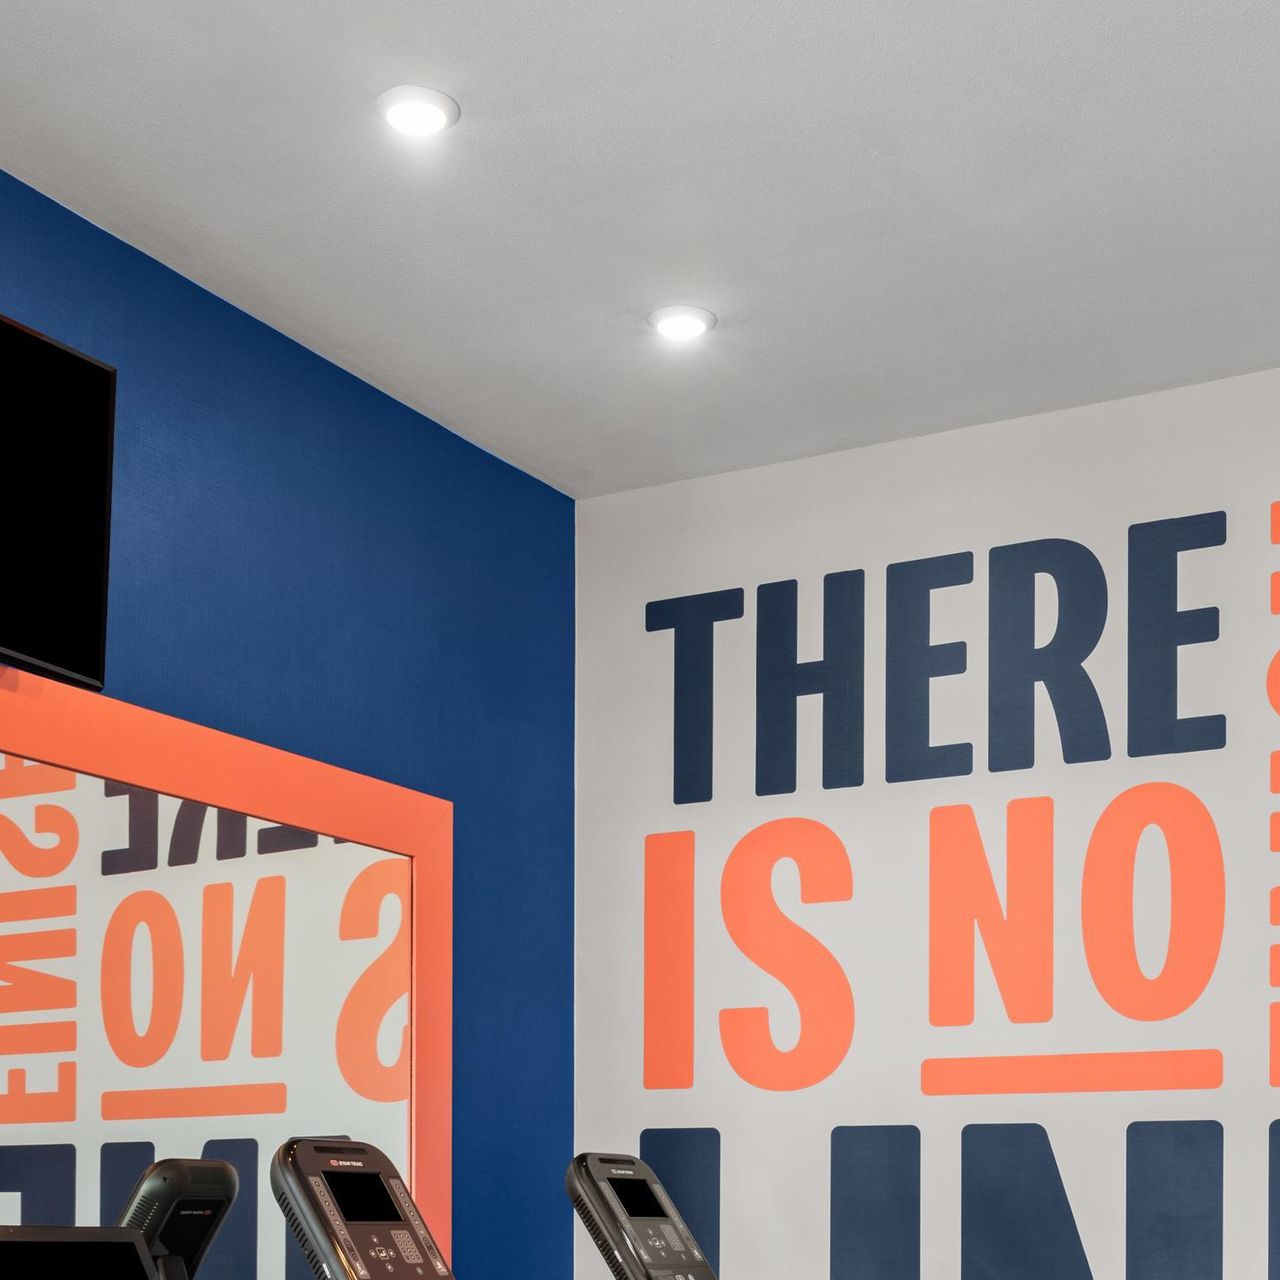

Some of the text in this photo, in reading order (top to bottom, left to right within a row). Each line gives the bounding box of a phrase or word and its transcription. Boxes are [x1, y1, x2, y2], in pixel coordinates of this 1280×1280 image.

[644, 511, 1227, 805] THERE
[643, 781, 1226, 1092] IS NO
